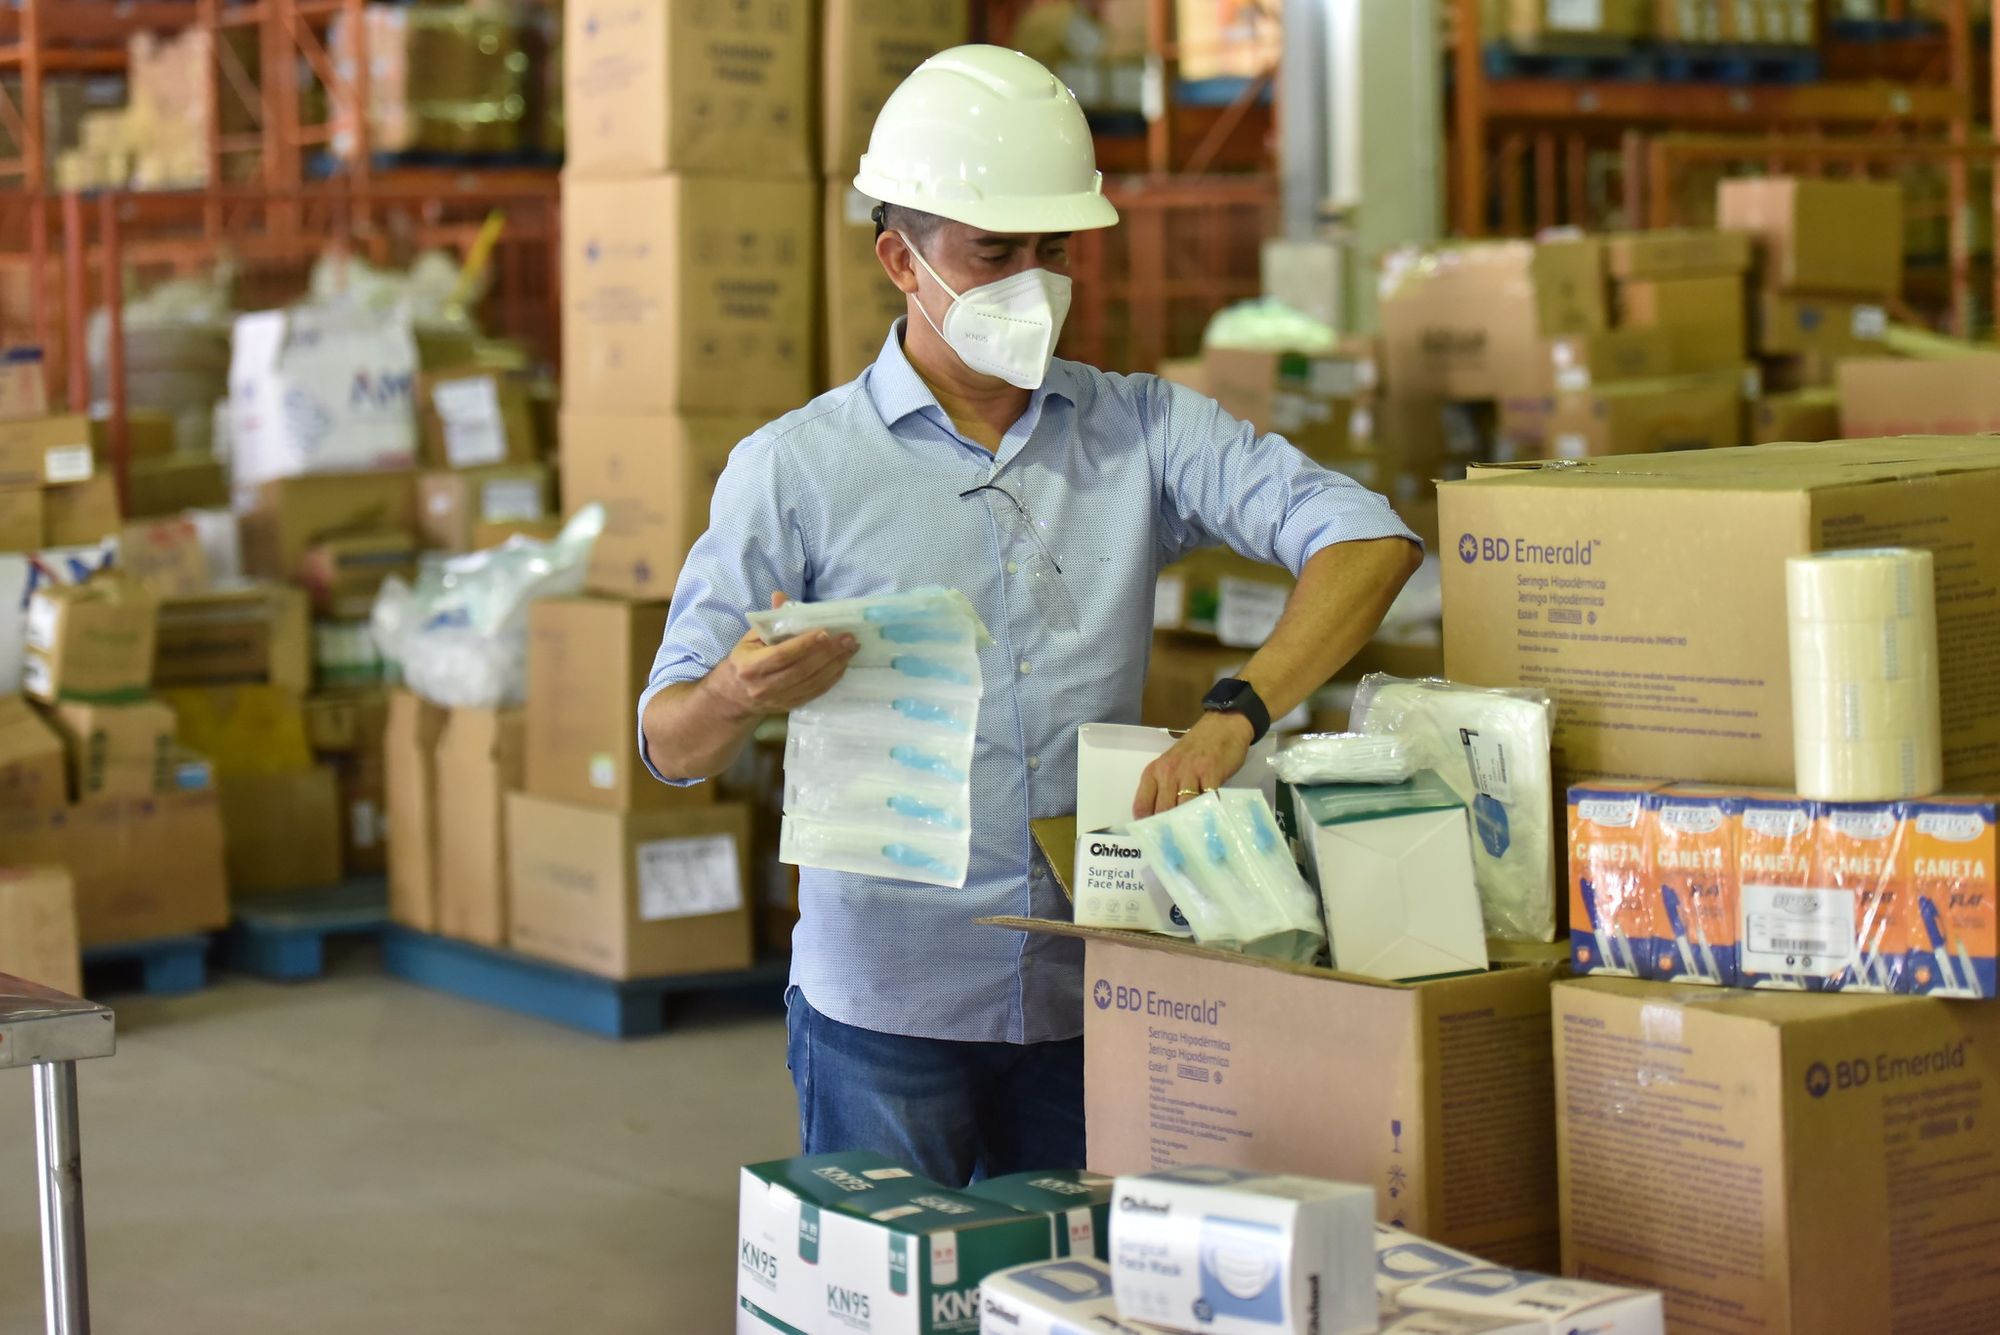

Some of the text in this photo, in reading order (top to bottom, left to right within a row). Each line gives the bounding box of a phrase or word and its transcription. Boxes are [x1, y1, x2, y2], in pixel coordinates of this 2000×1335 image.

[1482, 537, 1510, 562] BD
[1517, 575, 1606, 590] Seringa Hipodérmica
[1518, 591, 1548, 606] Jeringa
[1658, 848, 1723, 868] CANETA
[1740, 853, 1808, 873] CANETA
[1914, 858, 1985, 878] CANETA
[1088, 867, 1134, 880] Surgical
[1088, 879, 1145, 891] Face Mask
[1116, 985, 1142, 1012] BD
[1148, 1026, 1231, 1051] Seringa Hipodérmica
[1149, 1043, 1230, 1067] Jeringa Hipodérmica
[1836, 1058, 1870, 1091] BD
[817, 1166, 875, 1191] KN95
[741, 1238, 777, 1279] KN95
[827, 1284, 870, 1319] KN95
[932, 1288, 980, 1323] KN9
